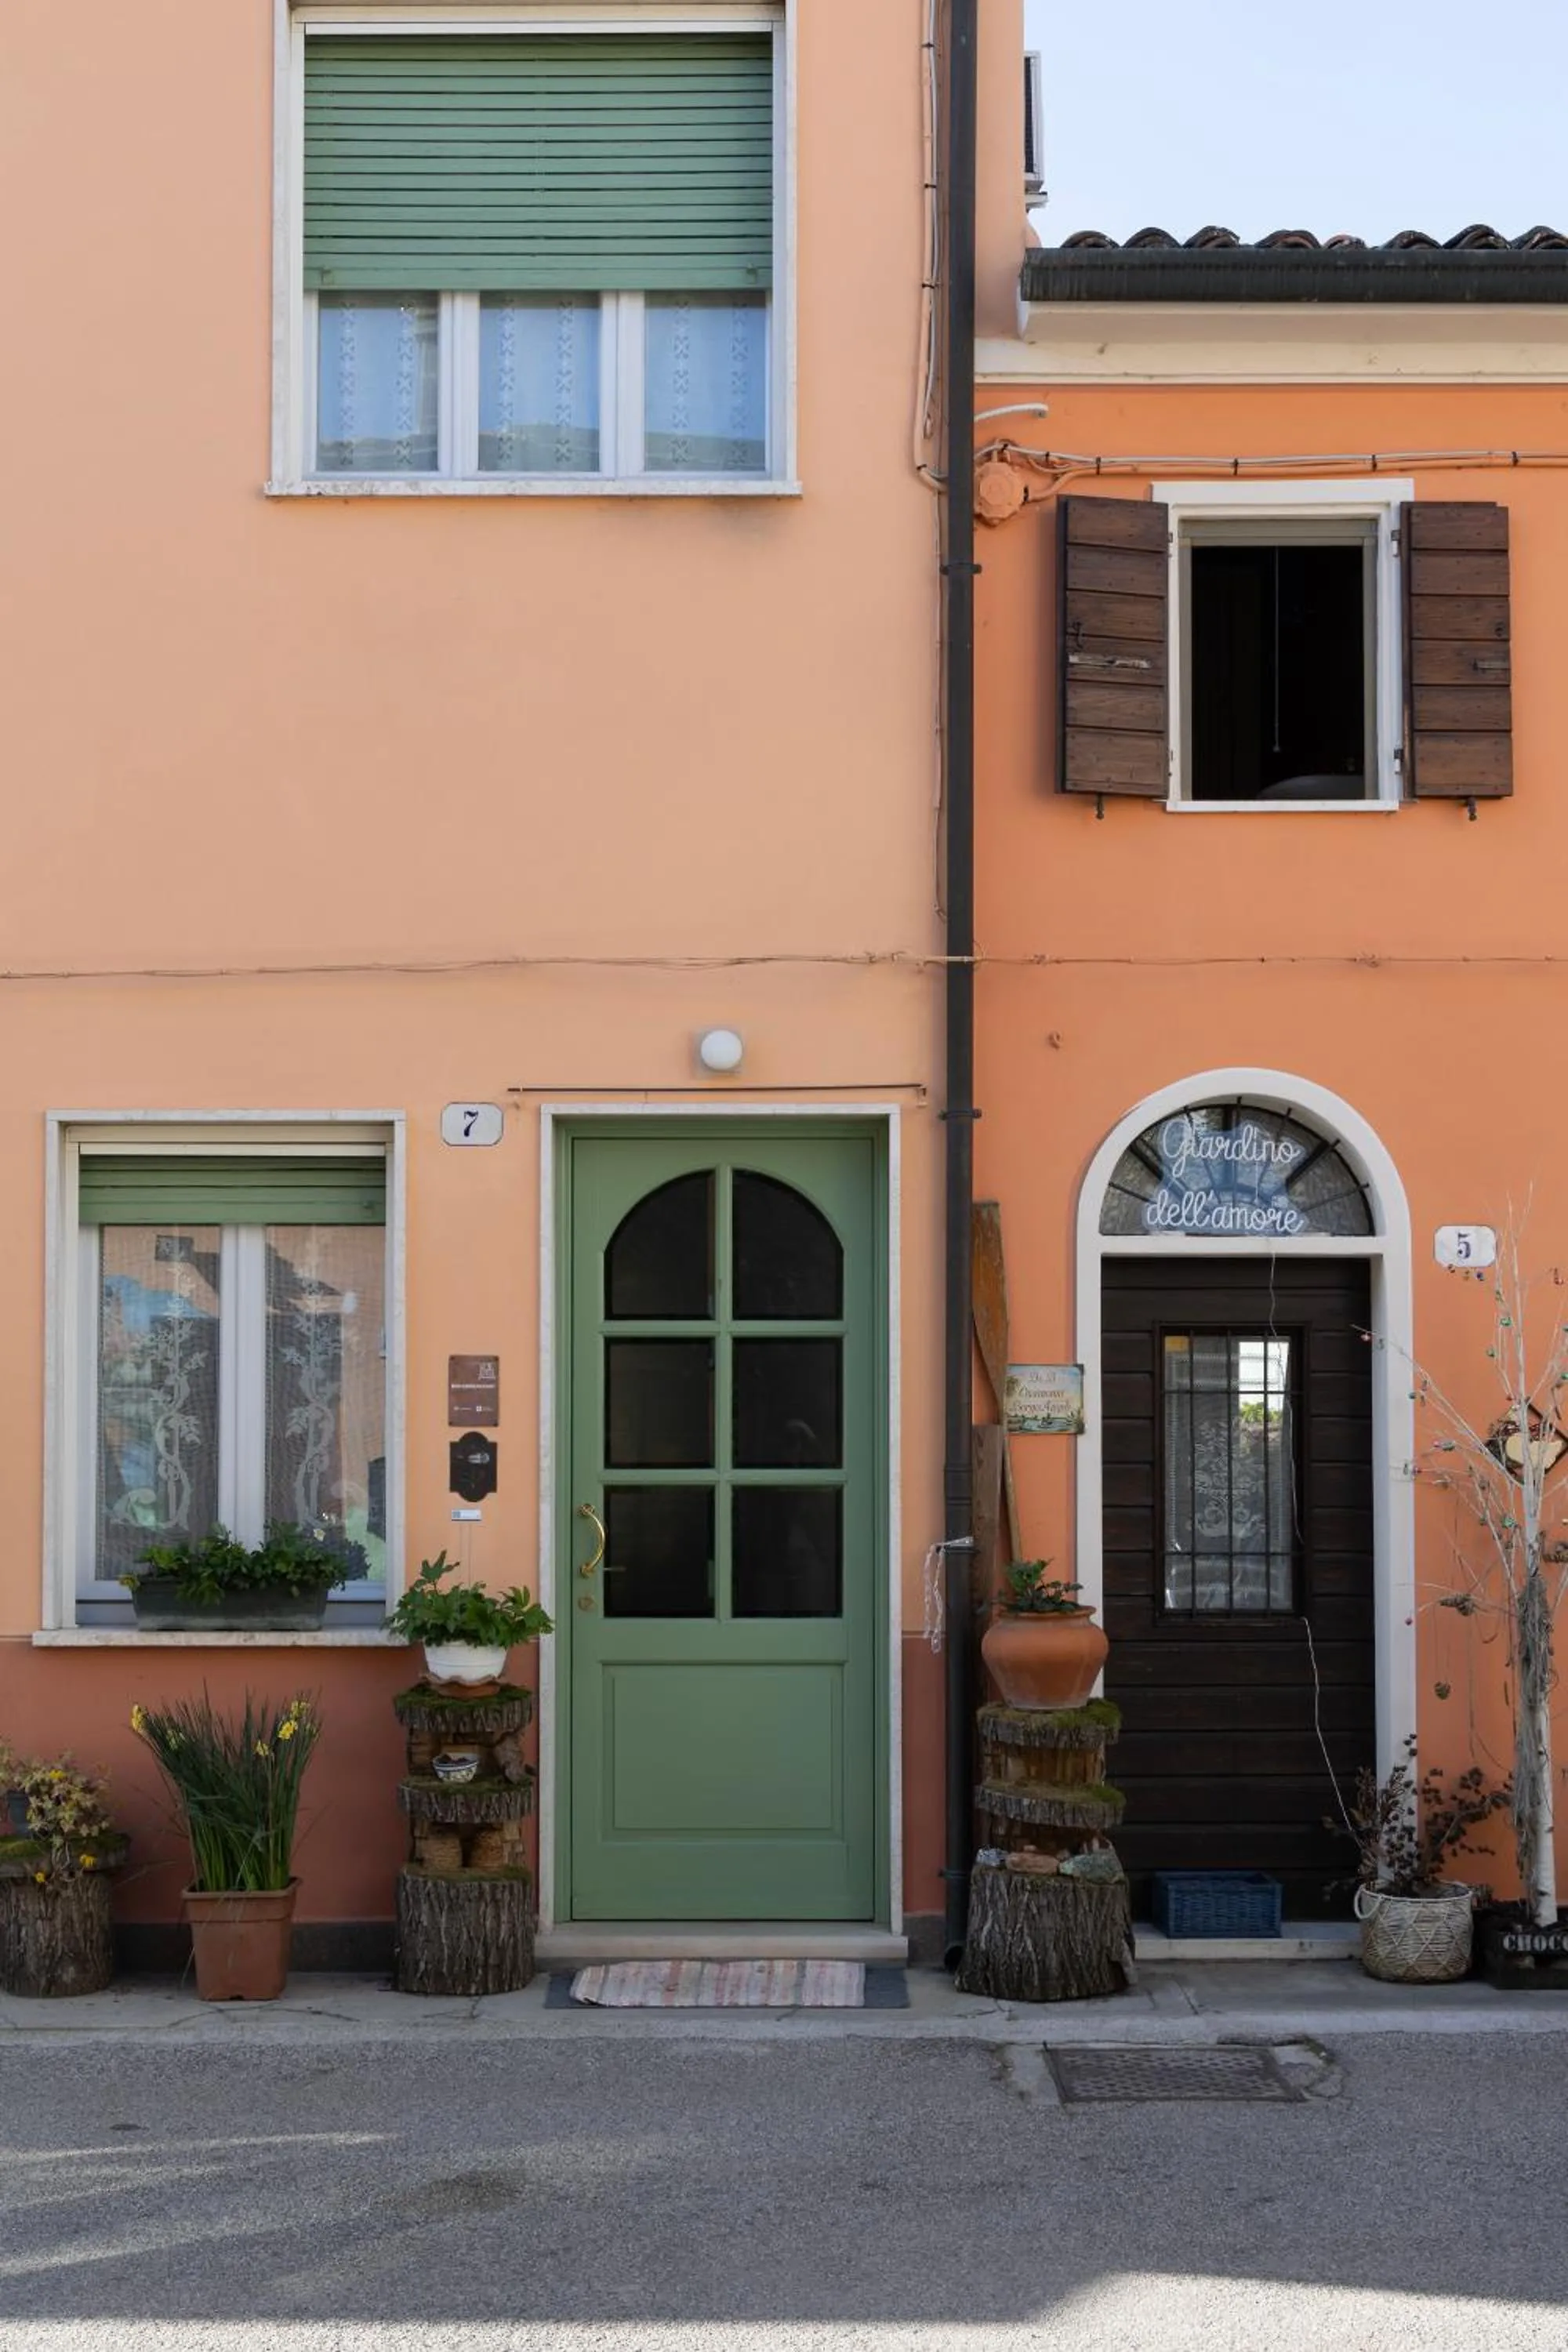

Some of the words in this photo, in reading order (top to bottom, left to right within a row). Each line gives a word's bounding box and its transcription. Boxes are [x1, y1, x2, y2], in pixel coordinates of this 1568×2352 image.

[463, 1110, 479, 1138] 7
[1161, 1120, 1300, 1177] Giardino
[1146, 1189, 1304, 1232] dell'amore
[1457, 1232, 1472, 1259] 5
